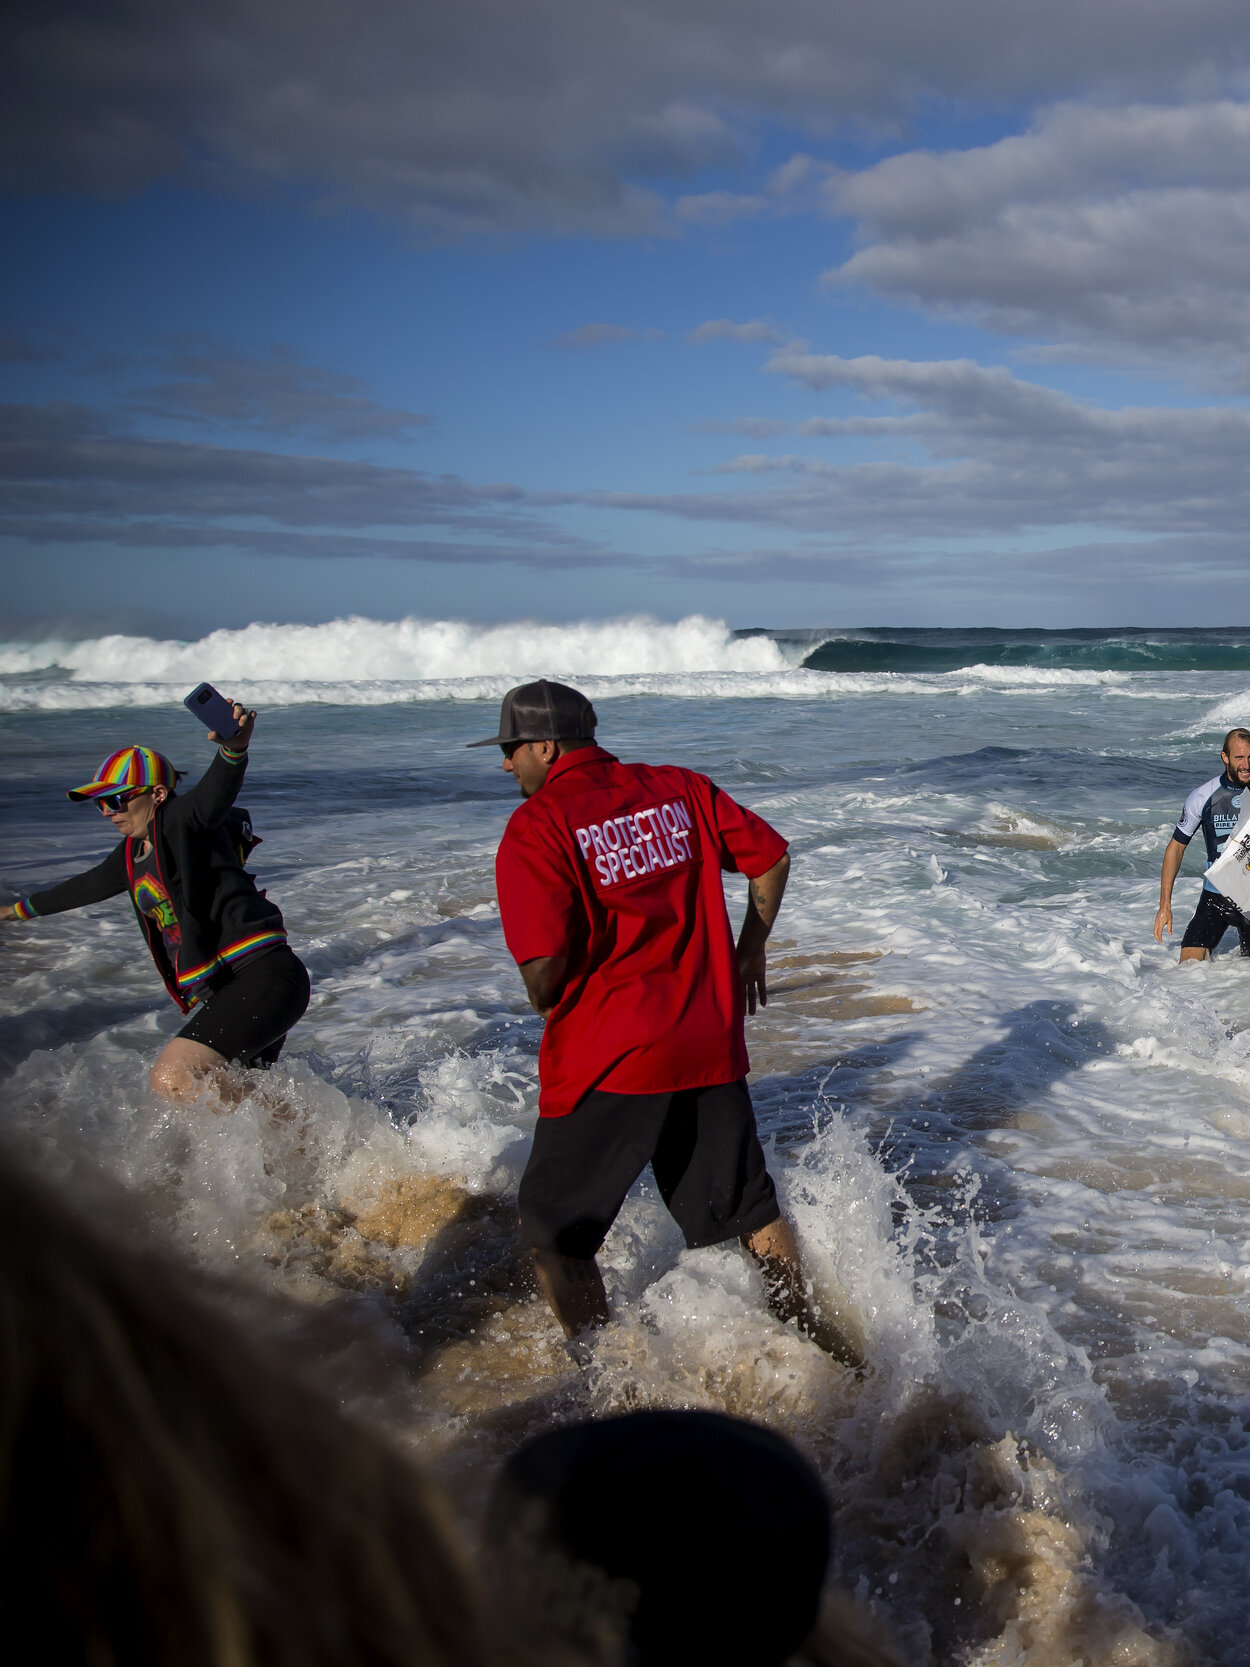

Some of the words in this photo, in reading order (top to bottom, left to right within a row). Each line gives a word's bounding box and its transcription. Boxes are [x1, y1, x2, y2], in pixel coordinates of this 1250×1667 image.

[575, 800, 692, 860] PROTECTION
[1213, 814, 1238, 822] BILLA
[594, 830, 693, 886] SPECIALIST
